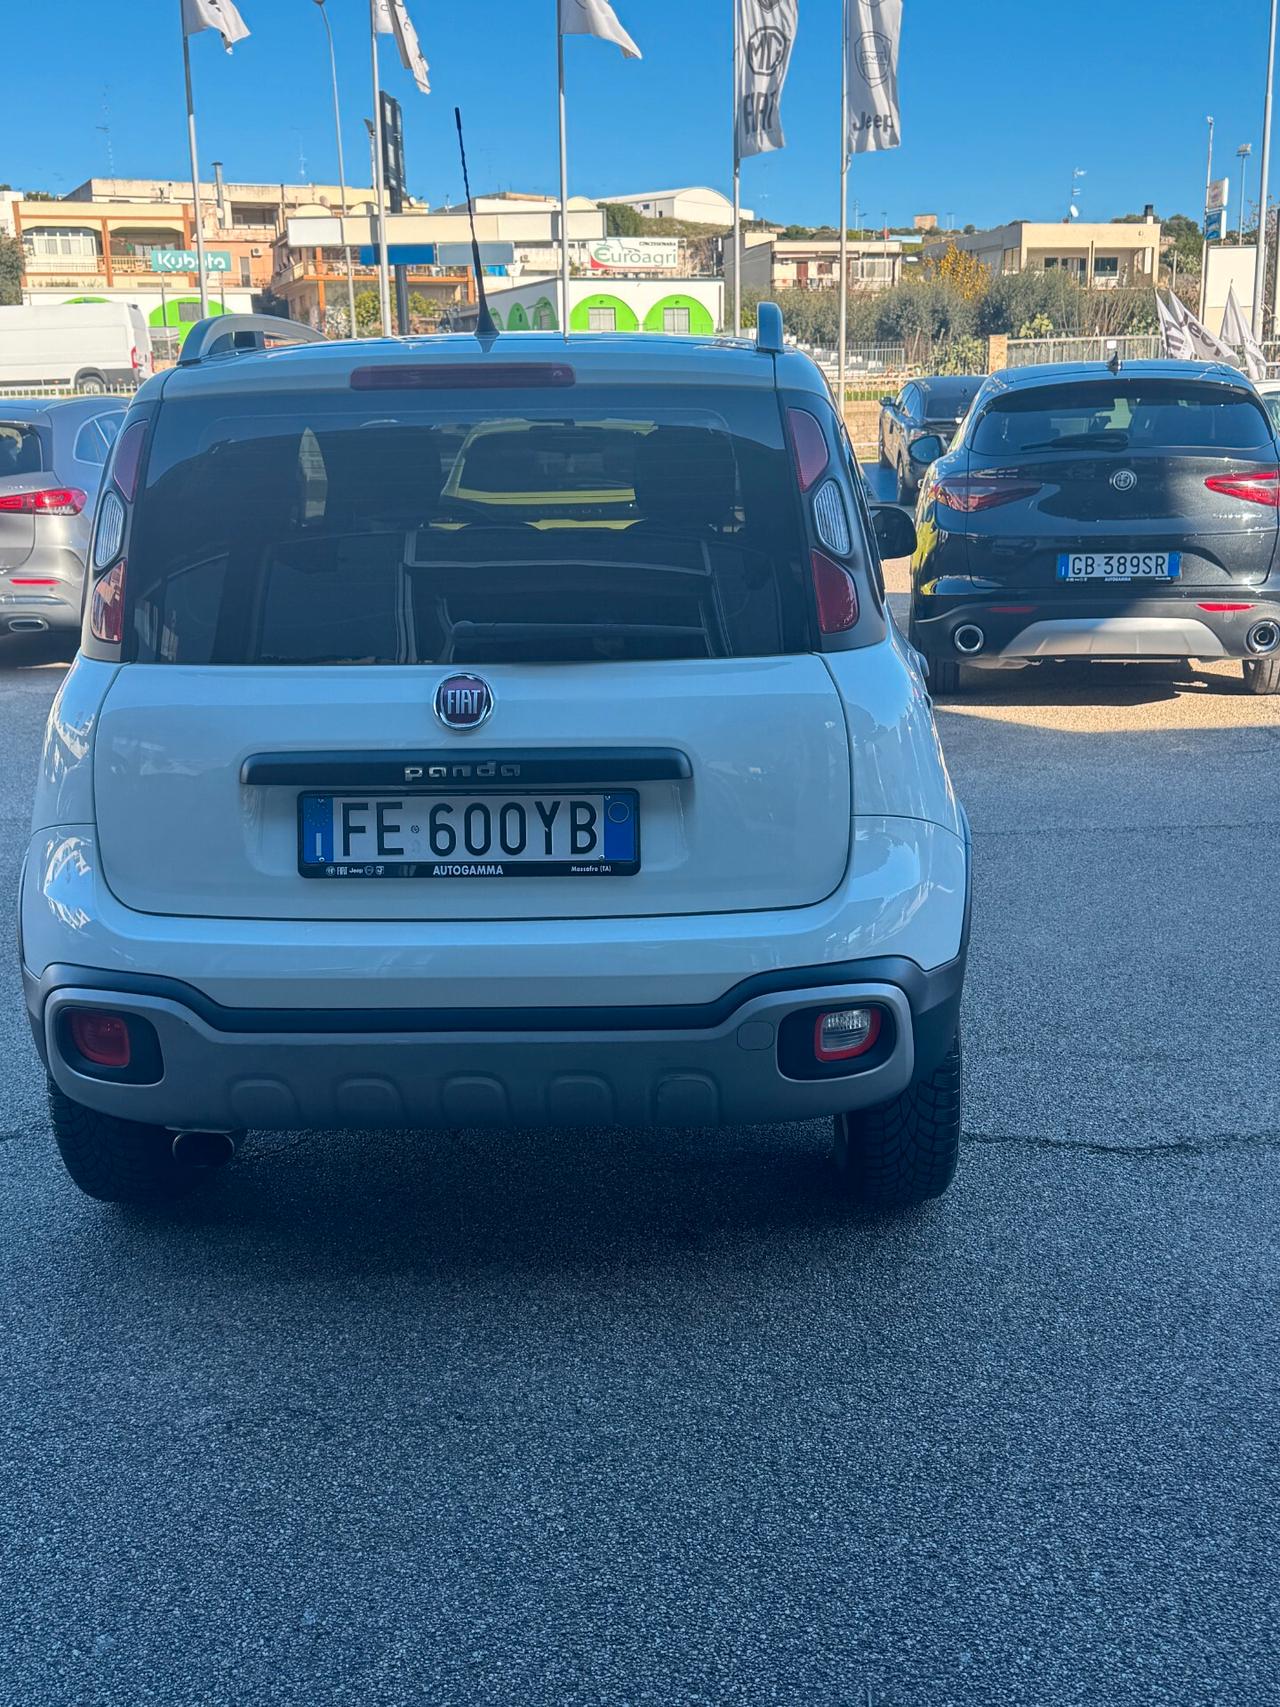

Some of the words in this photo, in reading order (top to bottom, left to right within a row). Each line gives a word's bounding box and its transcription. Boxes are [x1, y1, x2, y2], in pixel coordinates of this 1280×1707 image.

[853, 111, 894, 132] Jeep
[158, 253, 226, 269] Kubta
[594, 246, 676, 266] Euroagri
[1072, 556, 1095, 576] GB
[1103, 555, 1166, 575] 389SR
[447, 689, 481, 715] FIAT
[404, 760, 521, 781] panda
[342, 802, 404, 857] FE
[429, 801, 598, 857] 600YB
[433, 865, 504, 876] AUTOGAMMA
